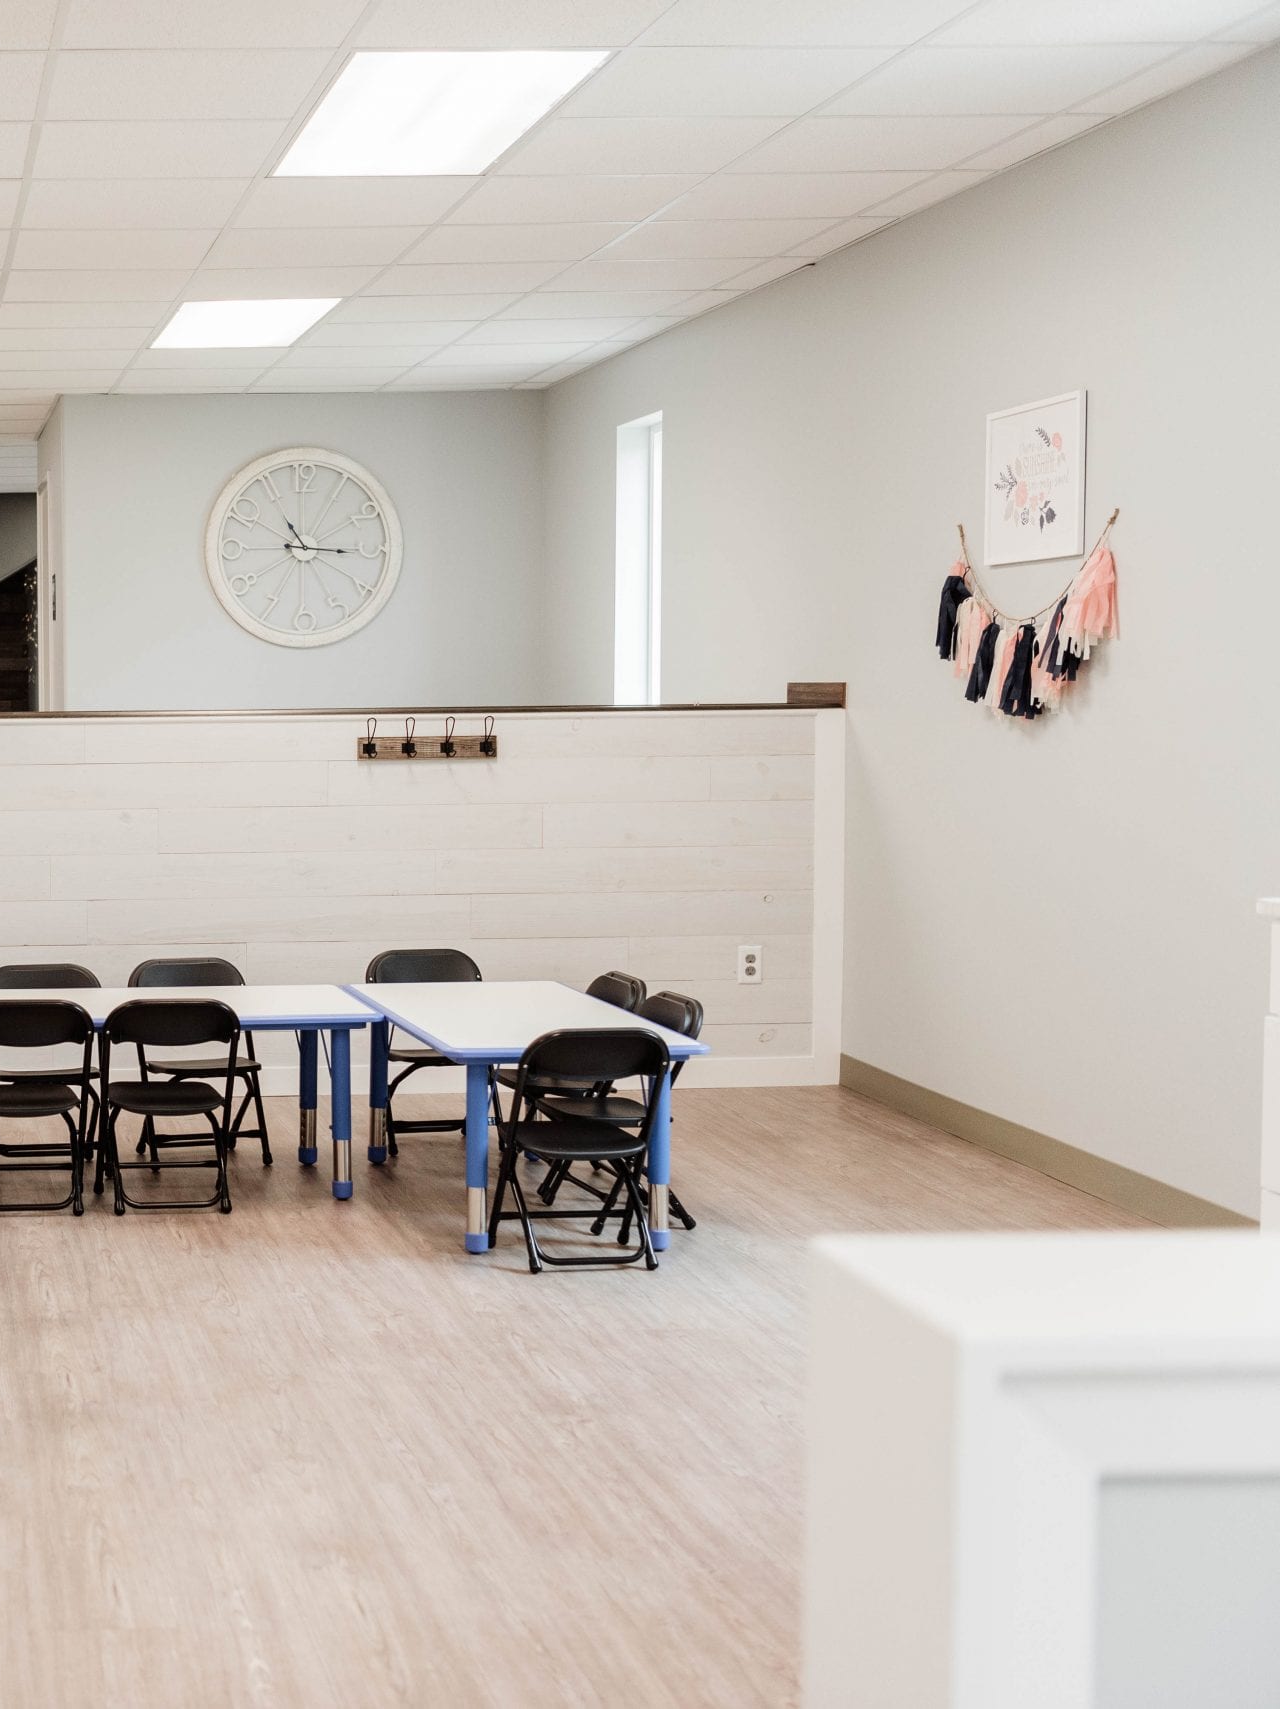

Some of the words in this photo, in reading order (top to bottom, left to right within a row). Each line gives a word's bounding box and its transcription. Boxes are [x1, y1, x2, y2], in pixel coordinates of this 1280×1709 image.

[258, 472, 282, 501] 11
[292, 464, 316, 493] 12
[227, 497, 261, 530] 10
[350, 501, 379, 528] 2
[221, 538, 248, 560] 9
[230, 572, 257, 596] 8
[353, 576, 376, 597] 4
[260, 593, 279, 621] 7
[294, 602, 317, 632] 6
[328, 596, 349, 620] 5
